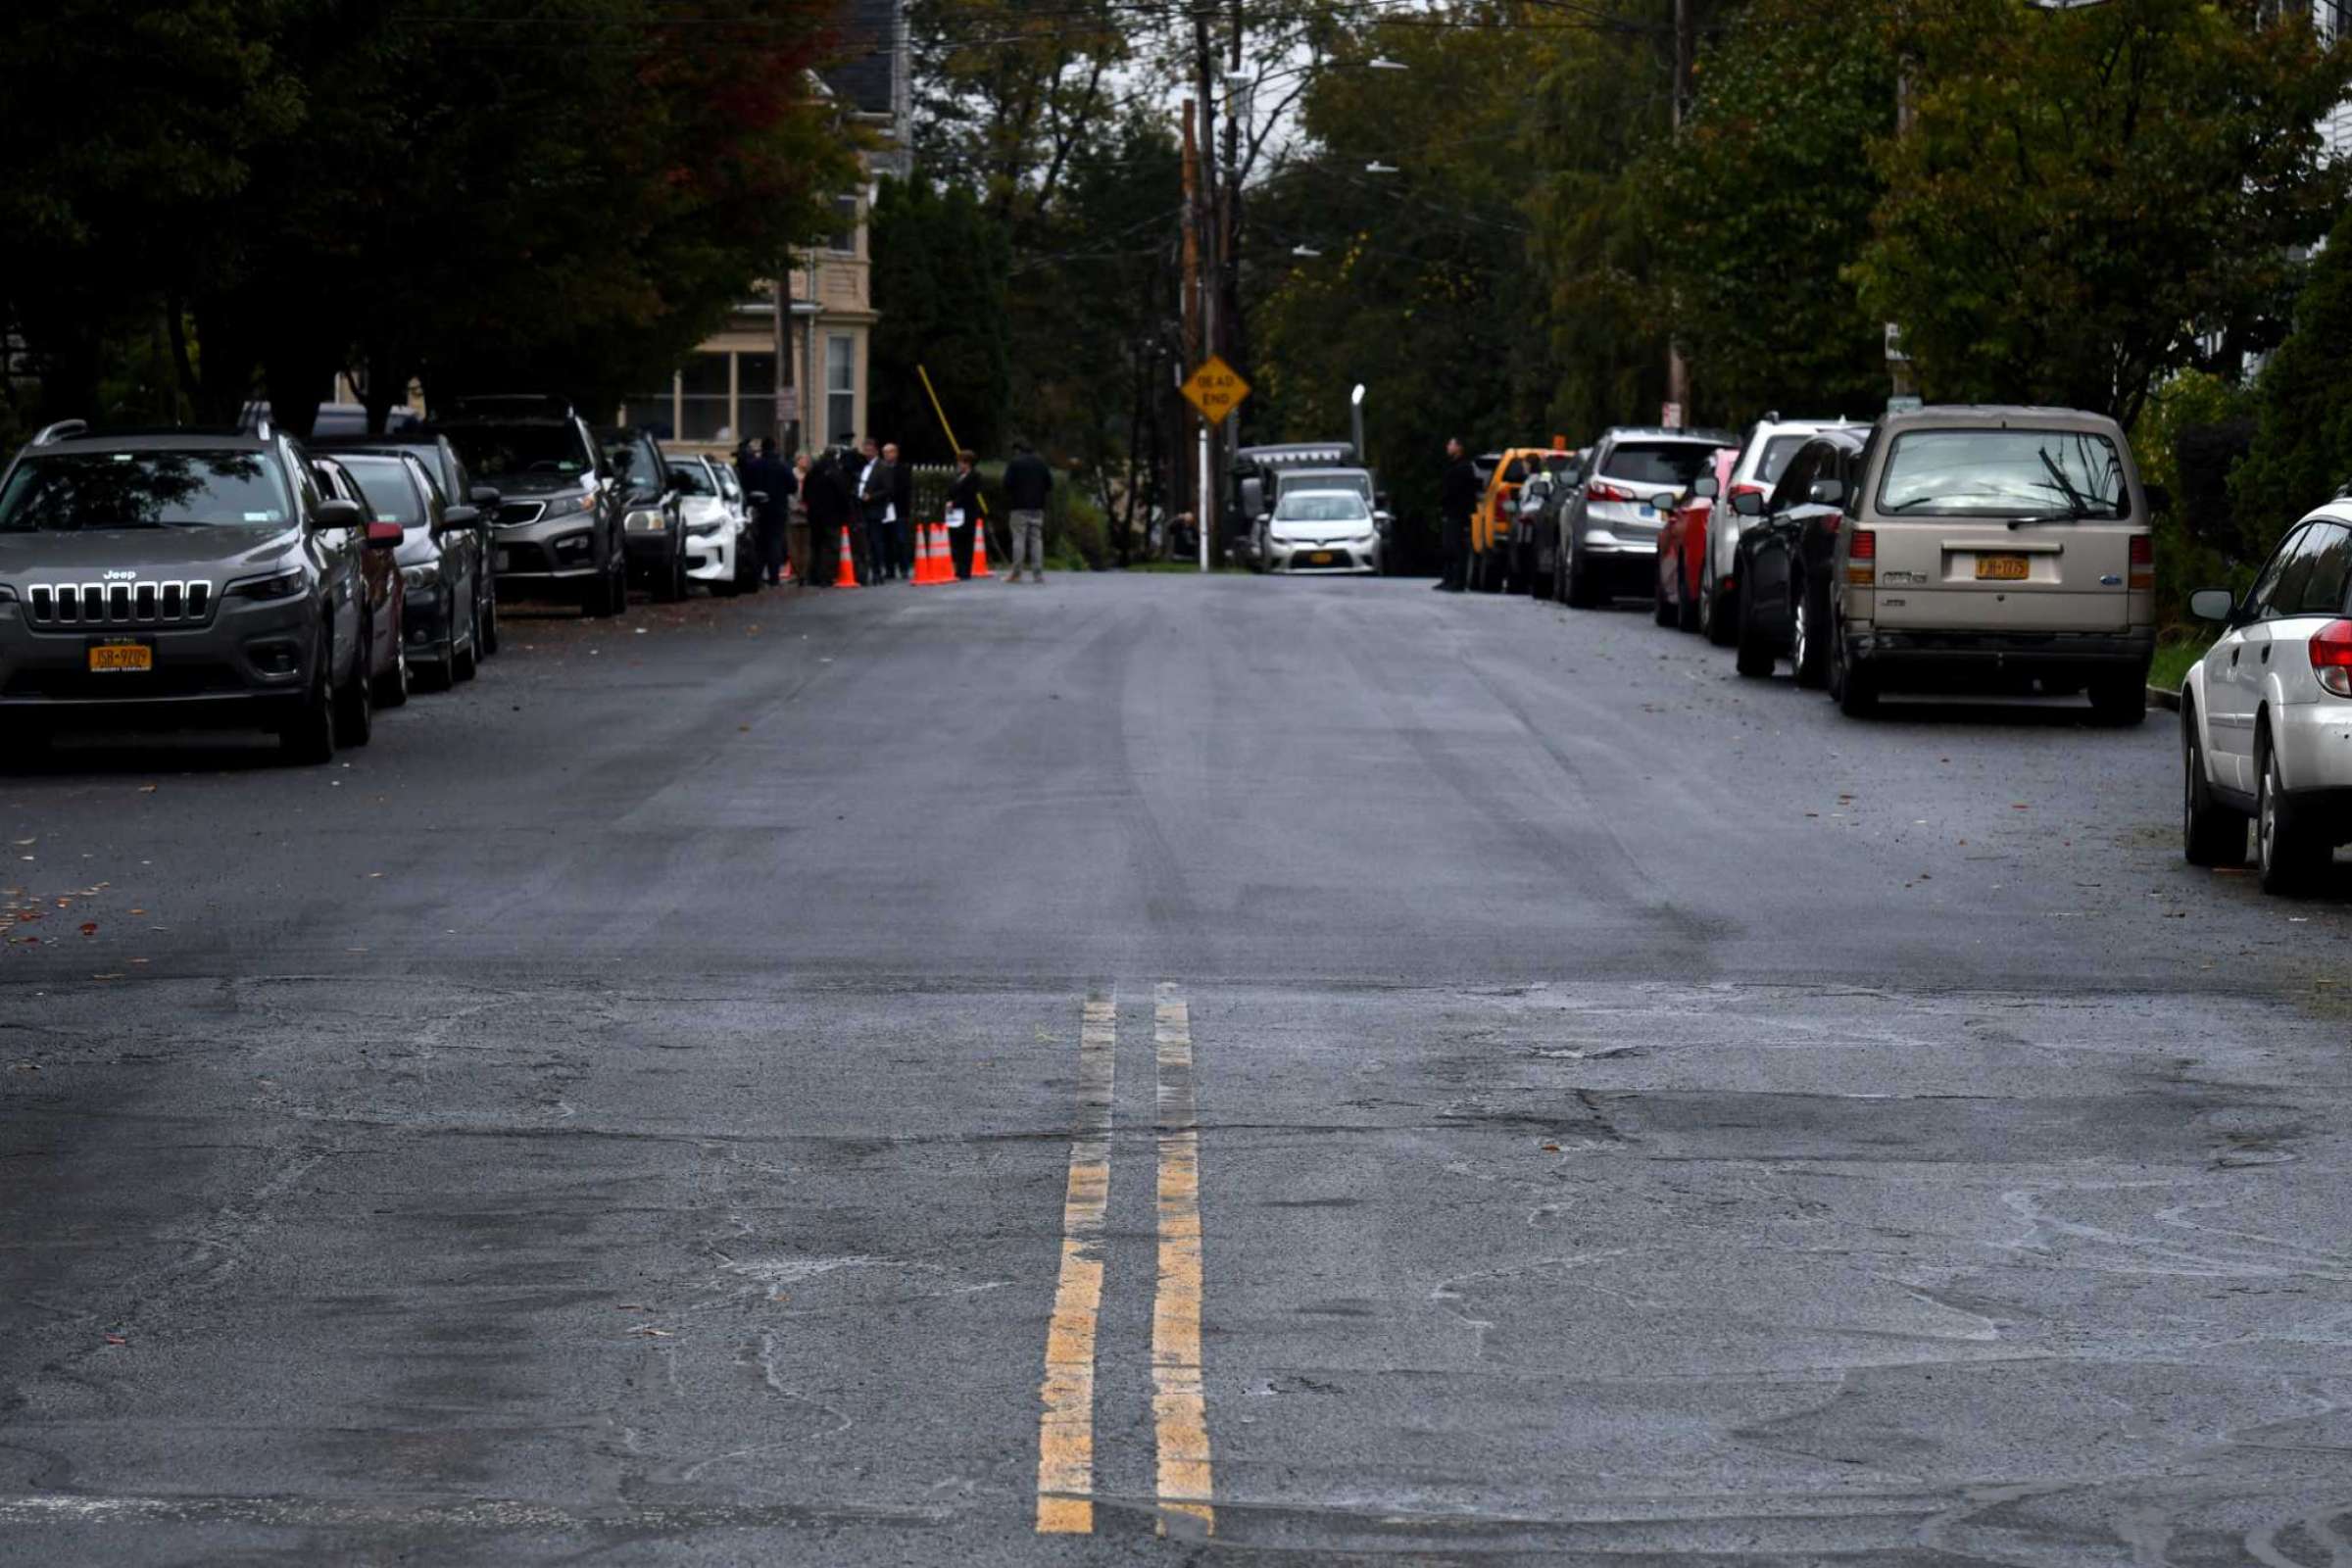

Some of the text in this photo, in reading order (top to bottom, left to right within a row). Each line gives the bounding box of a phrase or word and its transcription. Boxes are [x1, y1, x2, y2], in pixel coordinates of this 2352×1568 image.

[1198, 375, 1235, 388] DEAD
[1202, 393, 1230, 406] END
[103, 569, 137, 580] Jeep
